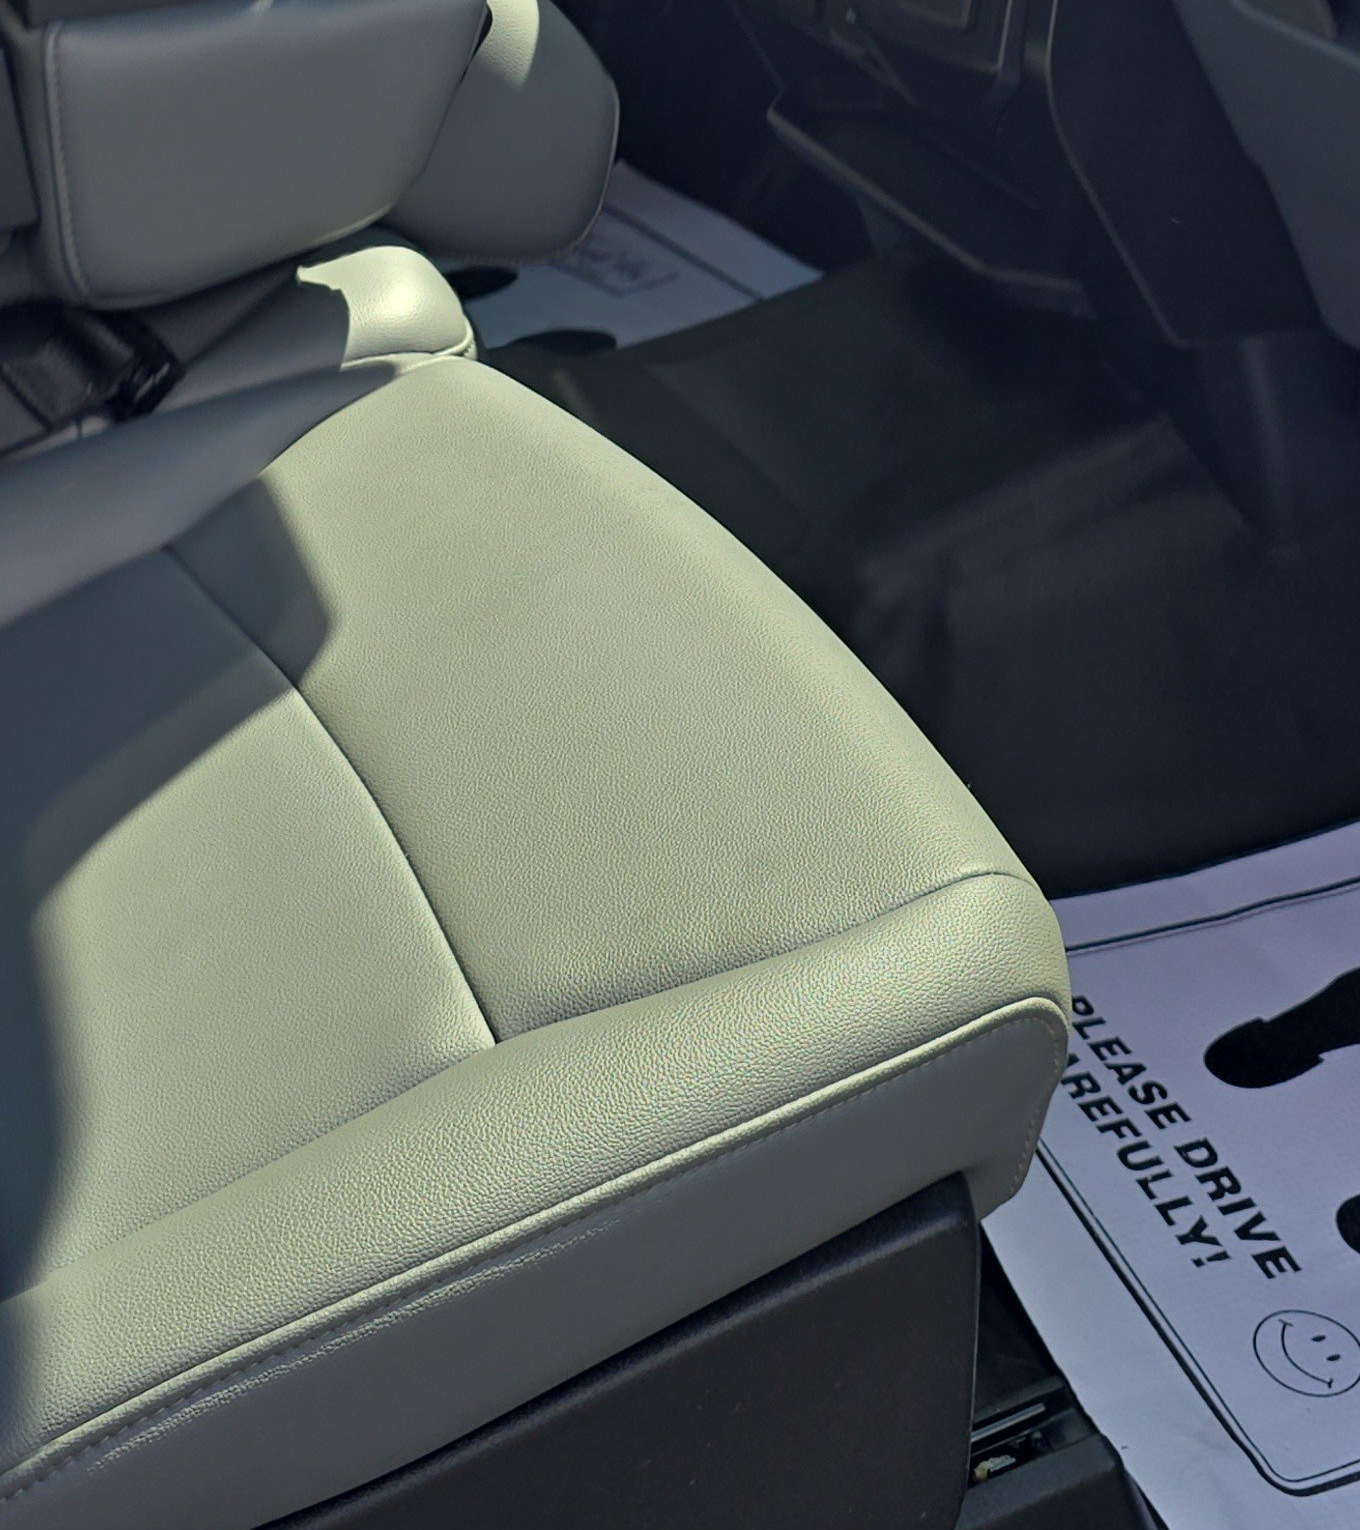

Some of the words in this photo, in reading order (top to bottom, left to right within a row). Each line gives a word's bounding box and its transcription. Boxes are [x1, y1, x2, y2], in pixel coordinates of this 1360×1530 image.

[1060, 1052, 1233, 1269] REFULLY!
[1072, 995, 1193, 1130] PLEASE
[1174, 1137, 1303, 1280] DRIVE
